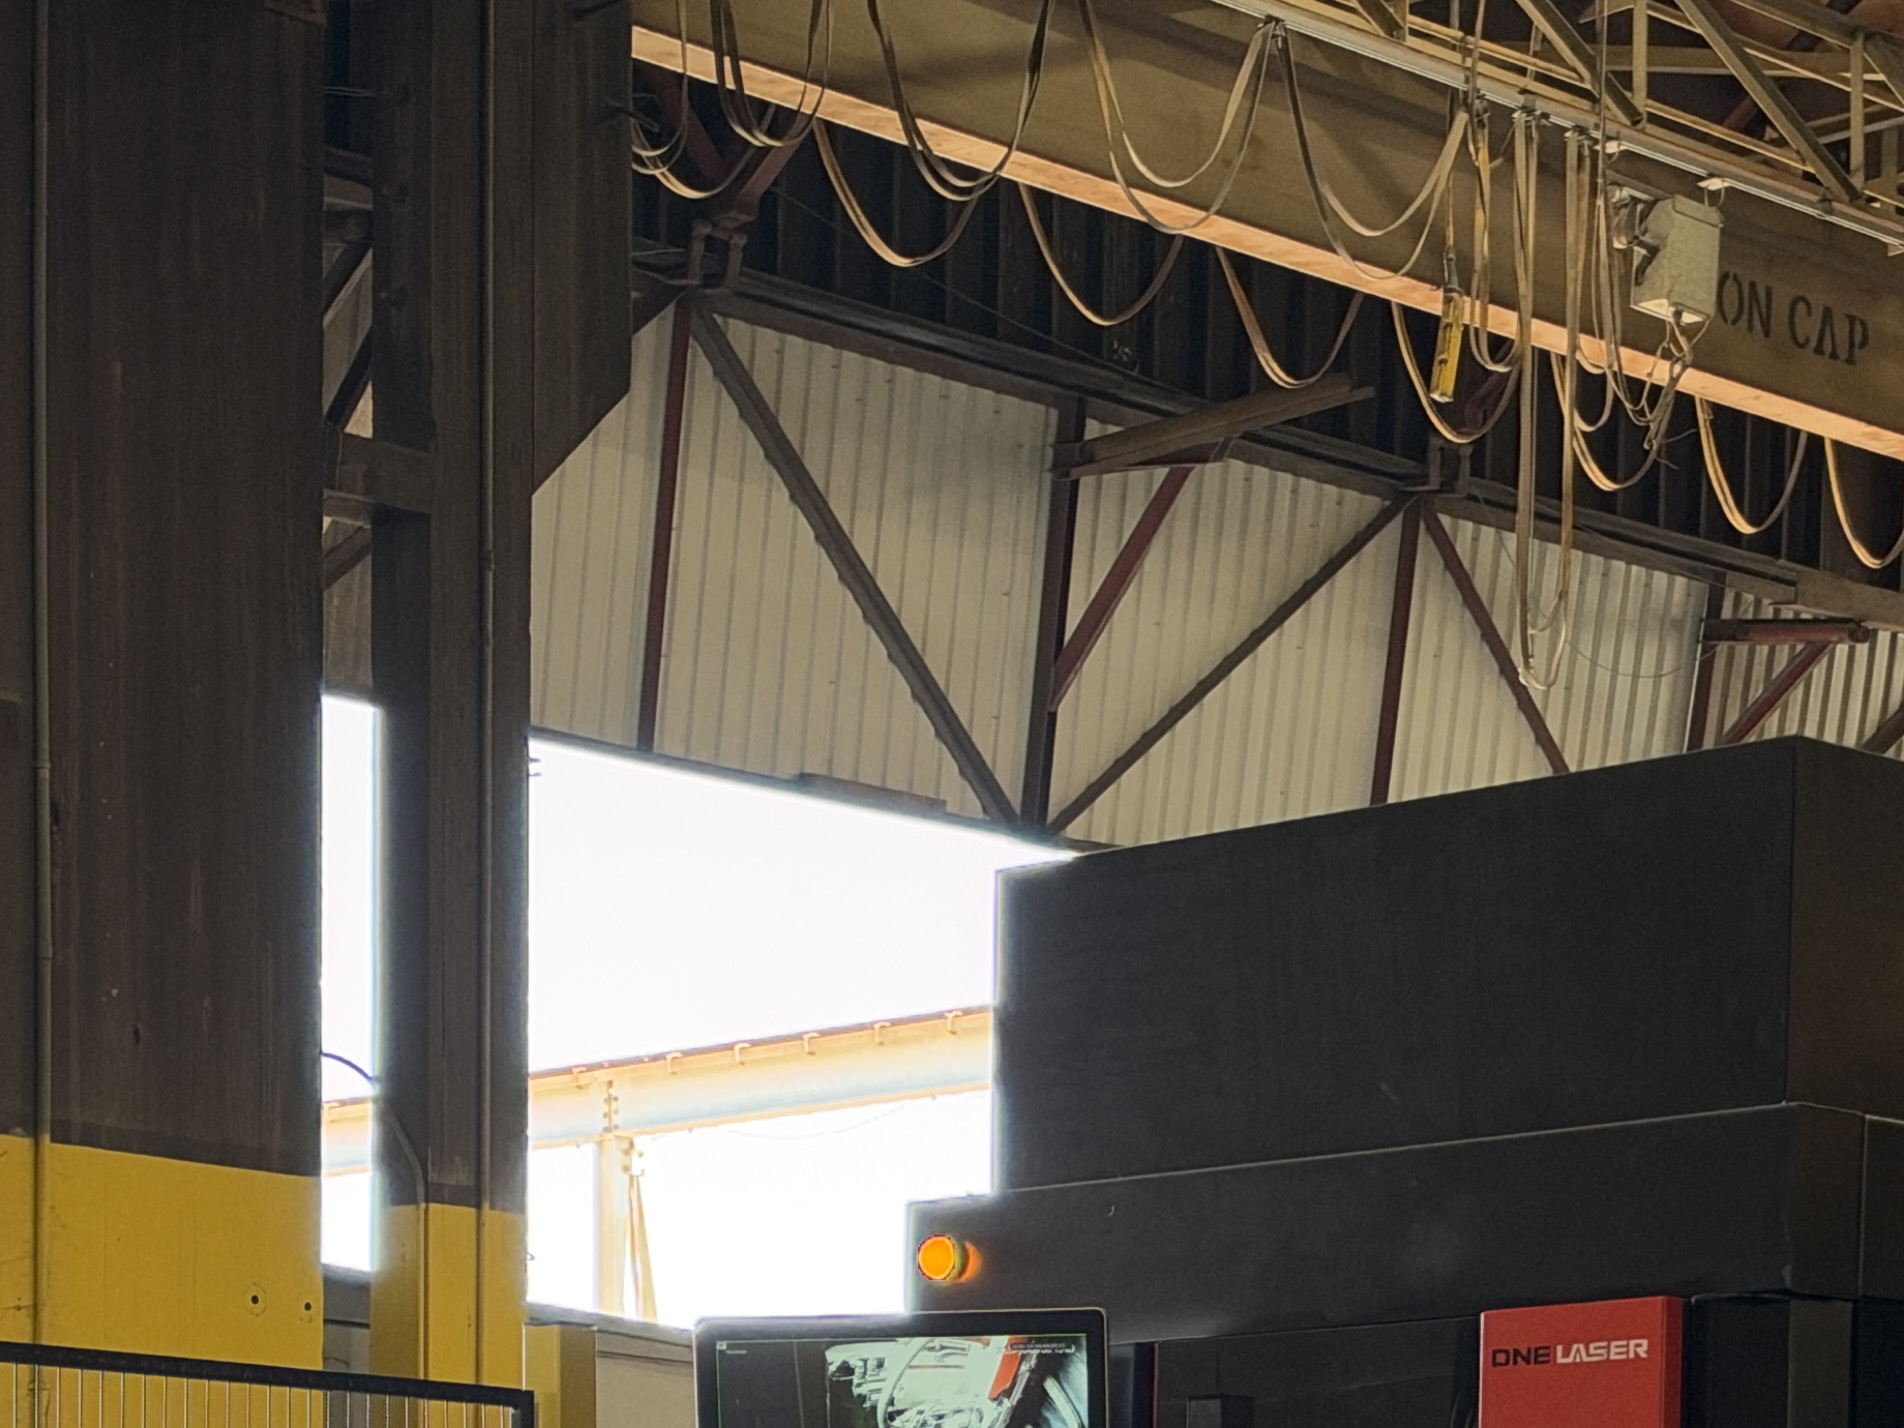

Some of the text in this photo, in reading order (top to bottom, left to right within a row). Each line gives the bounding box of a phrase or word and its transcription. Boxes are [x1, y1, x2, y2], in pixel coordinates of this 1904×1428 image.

[1788, 295, 1870, 366] CAP
[1492, 1338, 1649, 1368] ONE LASER
